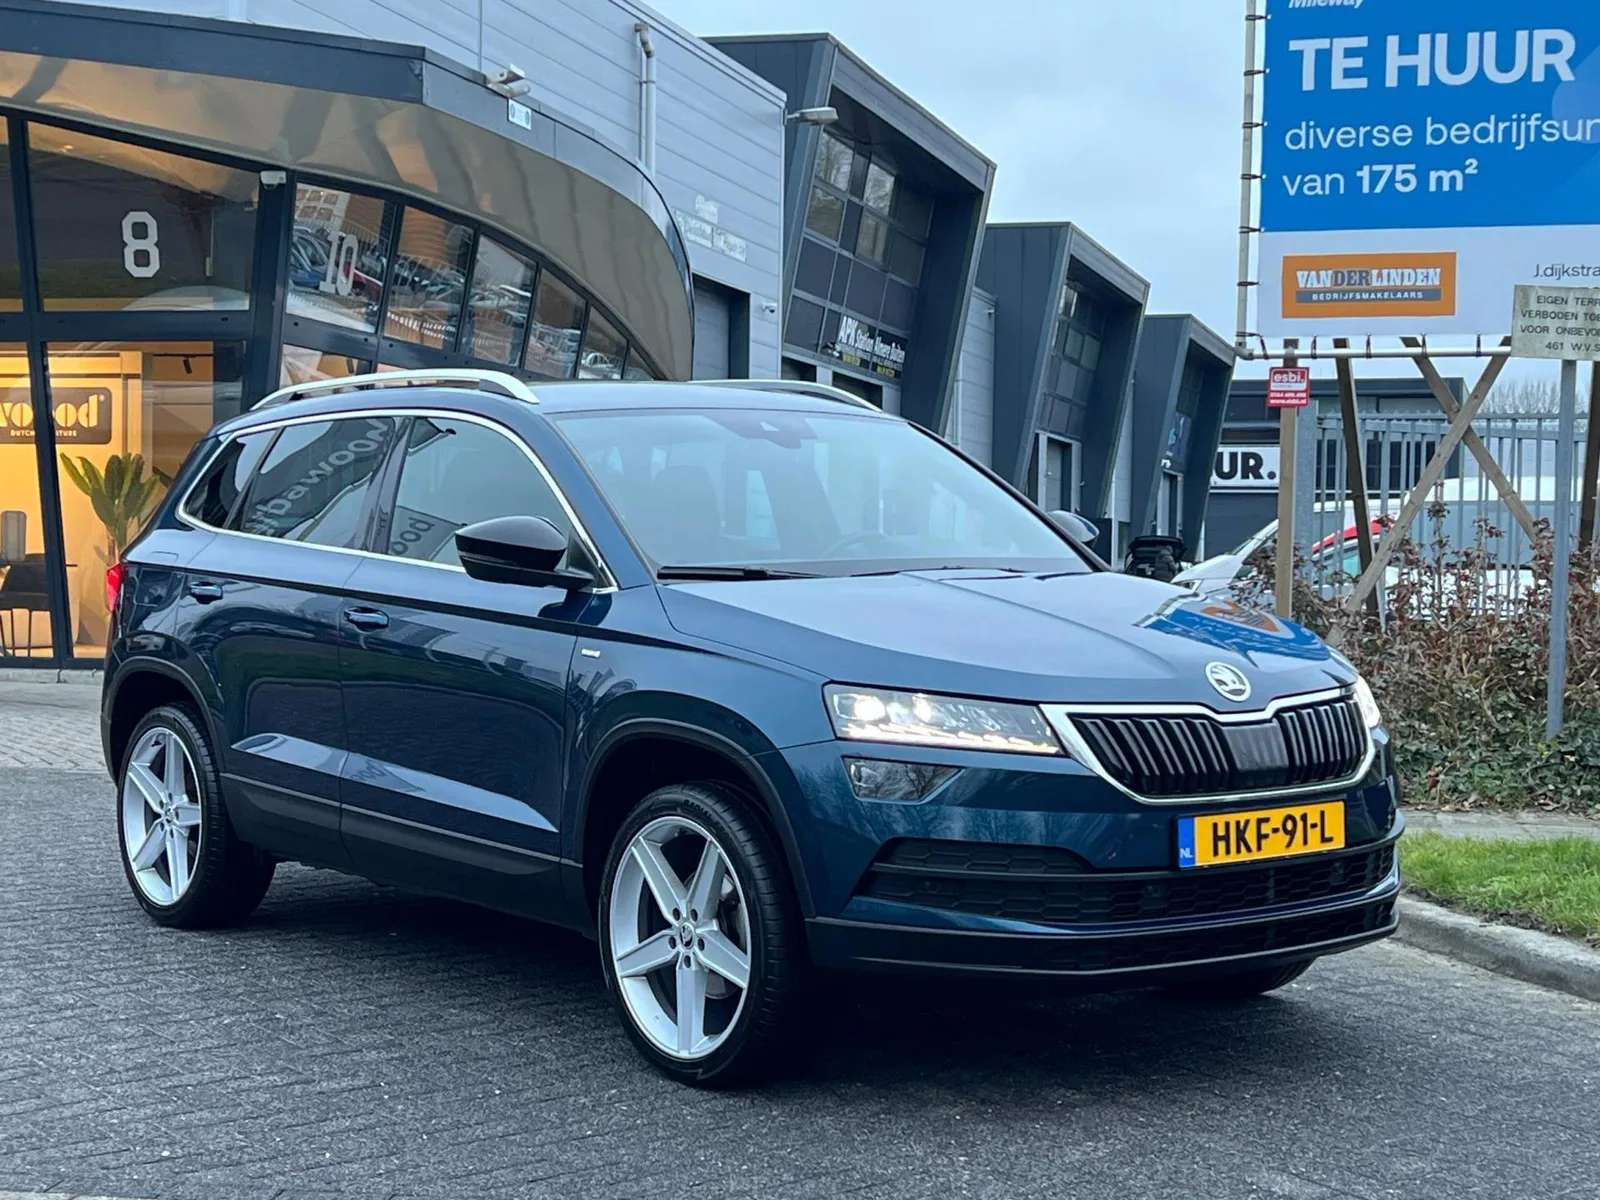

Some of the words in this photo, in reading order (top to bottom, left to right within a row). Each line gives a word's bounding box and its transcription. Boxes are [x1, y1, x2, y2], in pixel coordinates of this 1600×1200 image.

[1288, 36, 1368, 91] TE
[1385, 28, 1576, 88] HUUR
[1284, 120, 1413, 151] diverse
[1282, 171, 1345, 196] van
[1356, 163, 1417, 194] 175
[122, 211, 160, 278] 8
[319, 229, 359, 297] 10
[1312, 291, 1424, 301] BEDRIJFSMAKELAARS
[1536, 295, 1568, 305] EIGEN
[1520, 309, 1578, 321] VERBODEN
[1520, 325, 1549, 335] VOOR
[838, 315, 859, 347] APK
[1545, 341, 1564, 351] 461
[1212, 810, 1334, 857] HKF-91-L
[1180, 848, 1193, 859] NL
